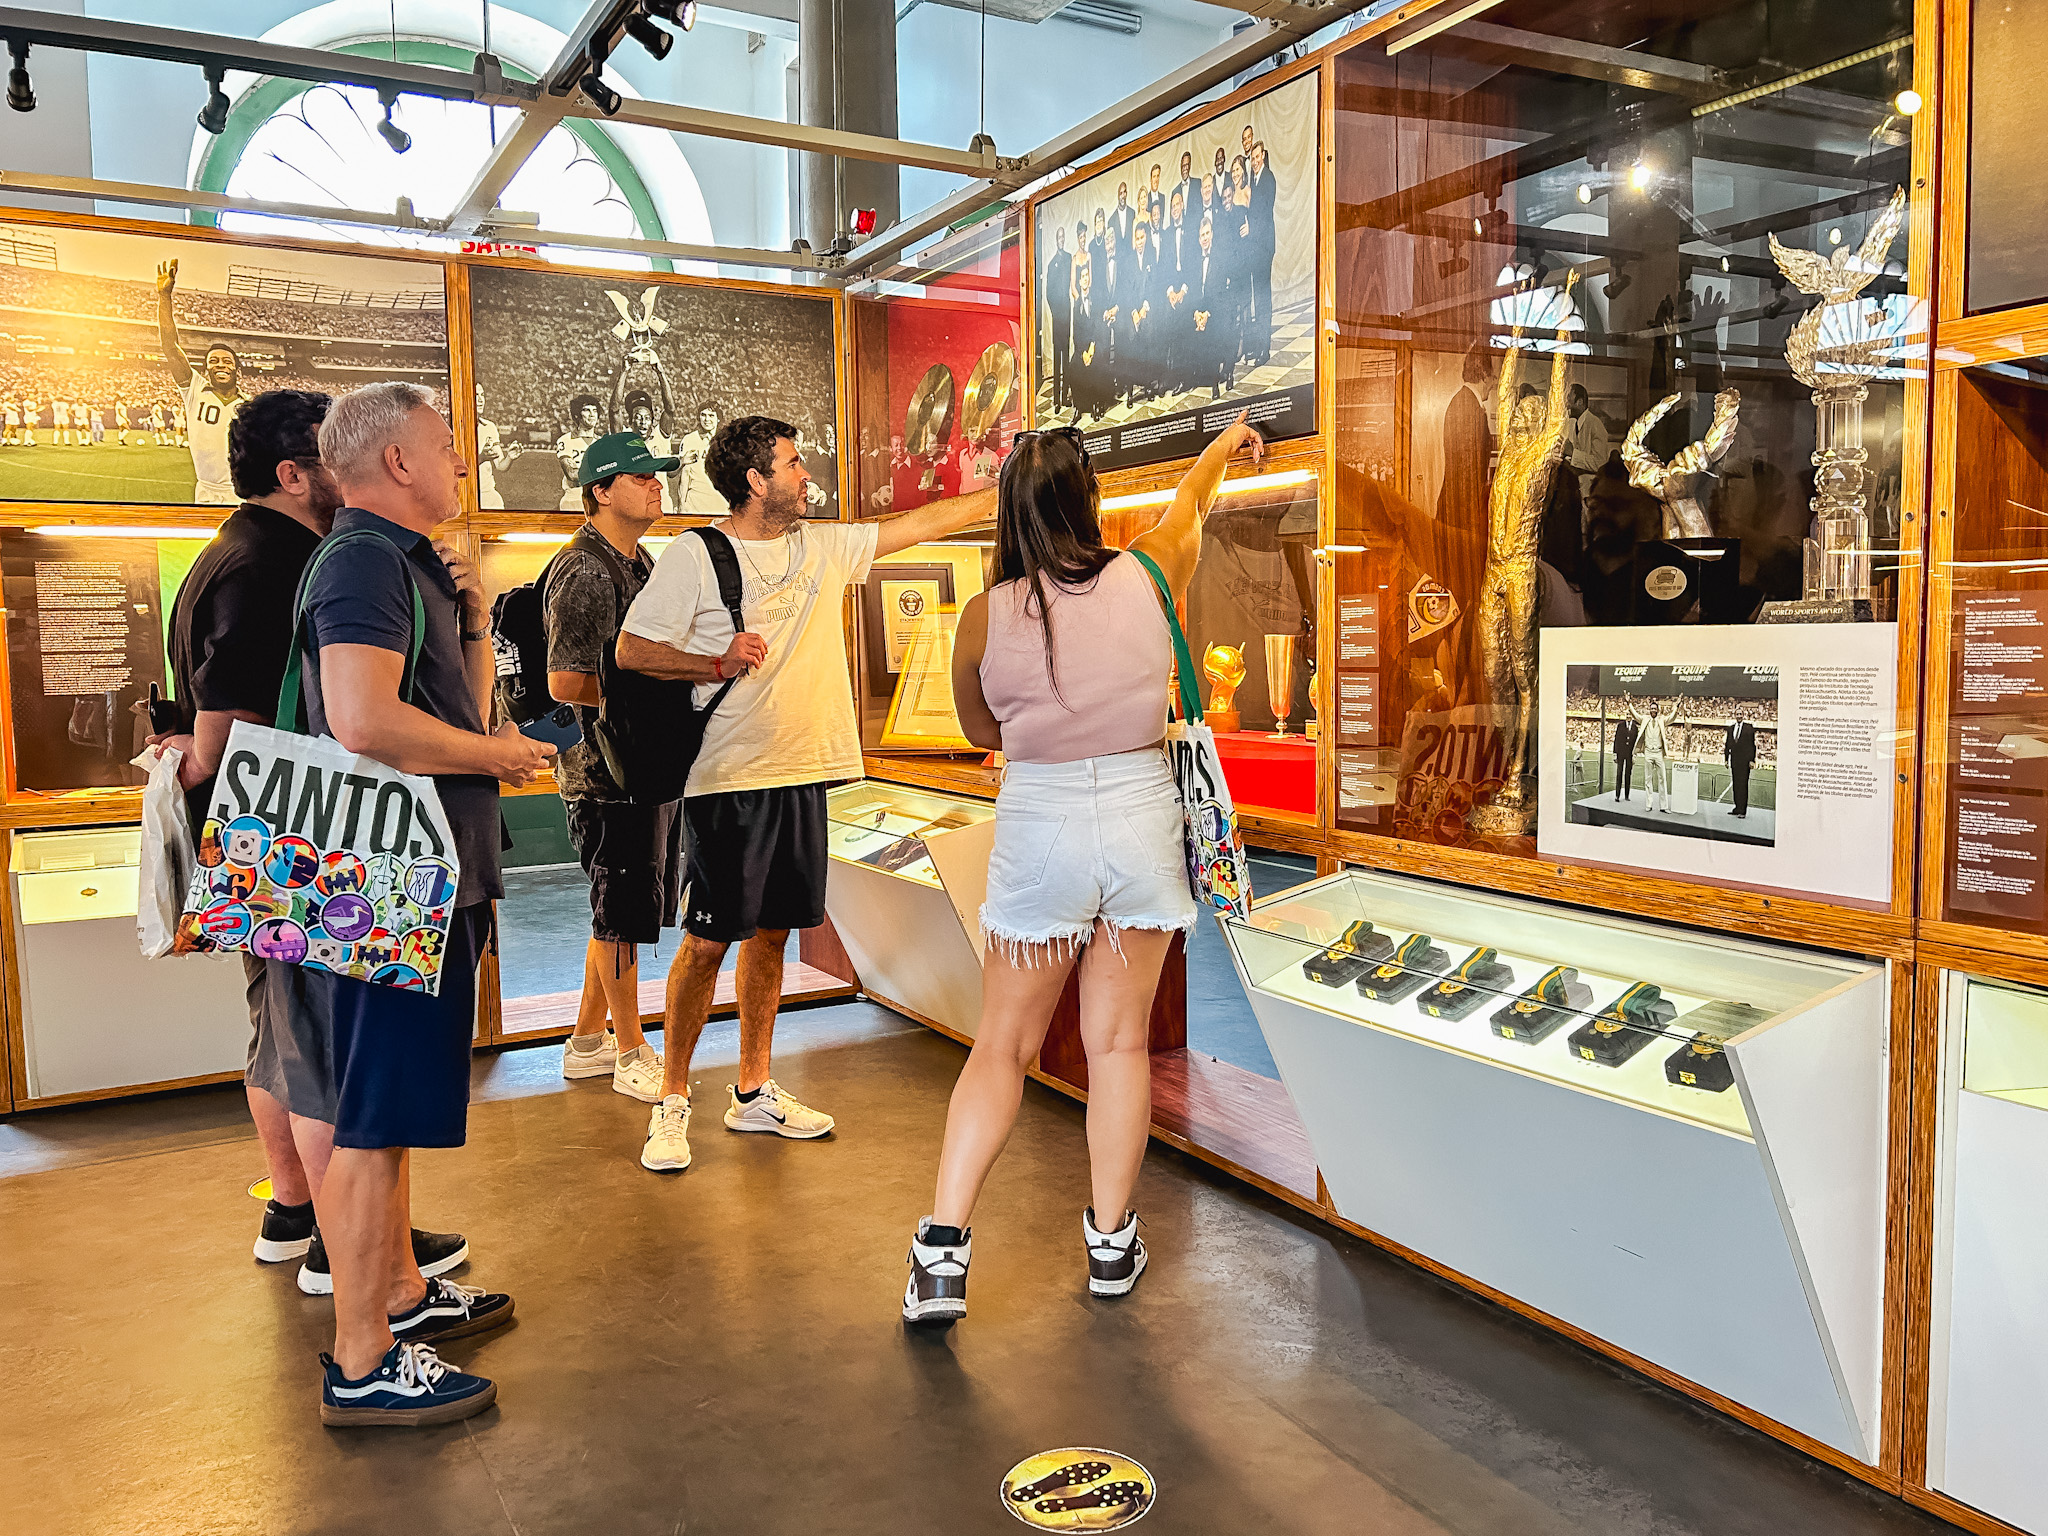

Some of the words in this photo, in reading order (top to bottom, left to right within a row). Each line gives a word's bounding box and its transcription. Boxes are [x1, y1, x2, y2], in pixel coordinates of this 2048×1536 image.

[197, 401, 221, 425] 10
[596, 461, 618, 473] aramco
[741, 569, 820, 613] PORTSWEAR
[766, 605, 796, 623] PUMA
[1620, 675, 1643, 683] magazine
[1679, 675, 1706, 683] magazine
[217, 750, 445, 859] SANTOS
